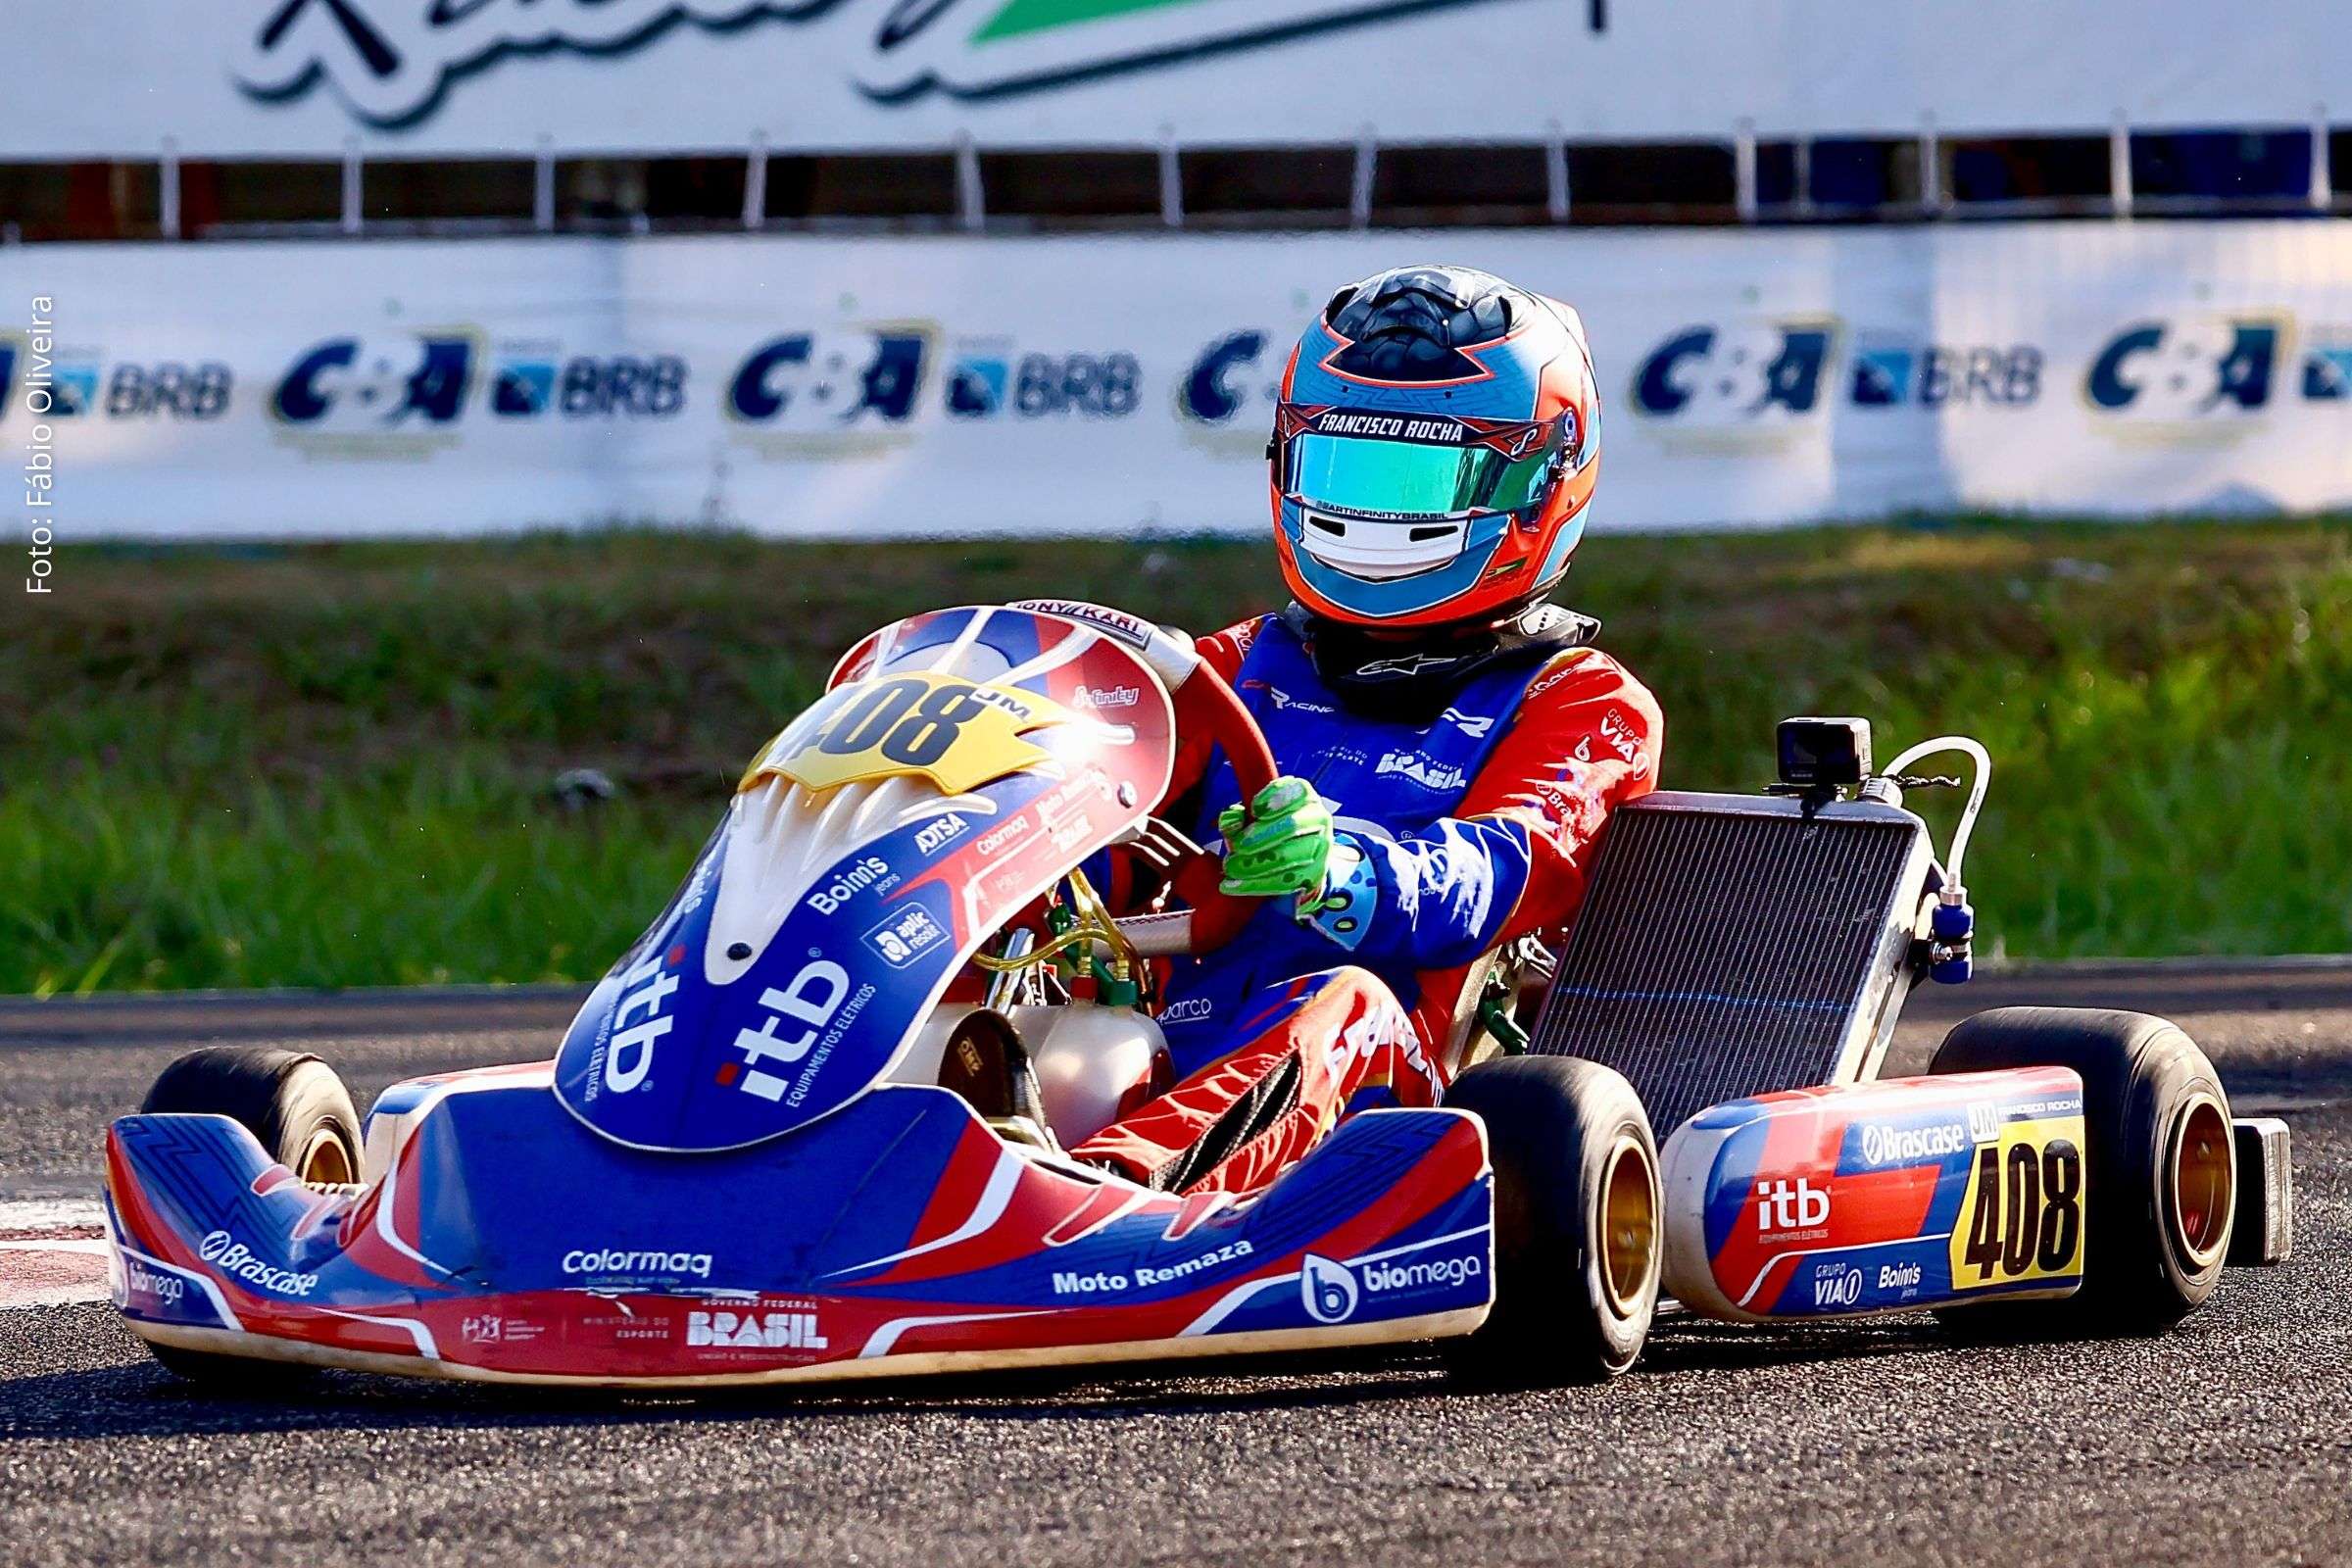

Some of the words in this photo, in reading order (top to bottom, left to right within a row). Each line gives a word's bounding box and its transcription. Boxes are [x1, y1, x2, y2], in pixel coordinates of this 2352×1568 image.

[106, 363, 233, 420] BRB
[561, 356, 689, 418] BRB
[1015, 353, 1141, 417] BRB
[1917, 344, 2044, 406] BRB
[1318, 414, 1404, 437] FRANCISCO
[1404, 420, 1463, 441] ROCHA
[977, 692, 1032, 719] JM
[1607, 708, 1644, 746] GRUPO
[914, 812, 968, 855] ADTSA
[715, 959, 850, 1102] itb
[1156, 998, 1212, 1026] parco
[786, 1029, 844, 1108] EQUIPAMENTOS
[834, 983, 877, 1030] ELÉTRICOS
[1971, 1103, 1998, 1137] JM
[2046, 1099, 2082, 1111] ROCHA
[1882, 1124, 1965, 1161] Brascase
[1757, 1177, 1831, 1231] itb
[1964, 1139, 2082, 1281] 408
[217, 1243, 319, 1297] Brascase
[1053, 1271, 1128, 1295] Moto
[1134, 1239, 1254, 1287] Remaza
[1362, 1254, 1482, 1293] biomega
[1815, 1262, 1846, 1278] GRUPO
[701, 1298, 760, 1307] GOVERNO
[762, 1299, 817, 1310] FEDERAL
[687, 1310, 829, 1349] BRASIL
